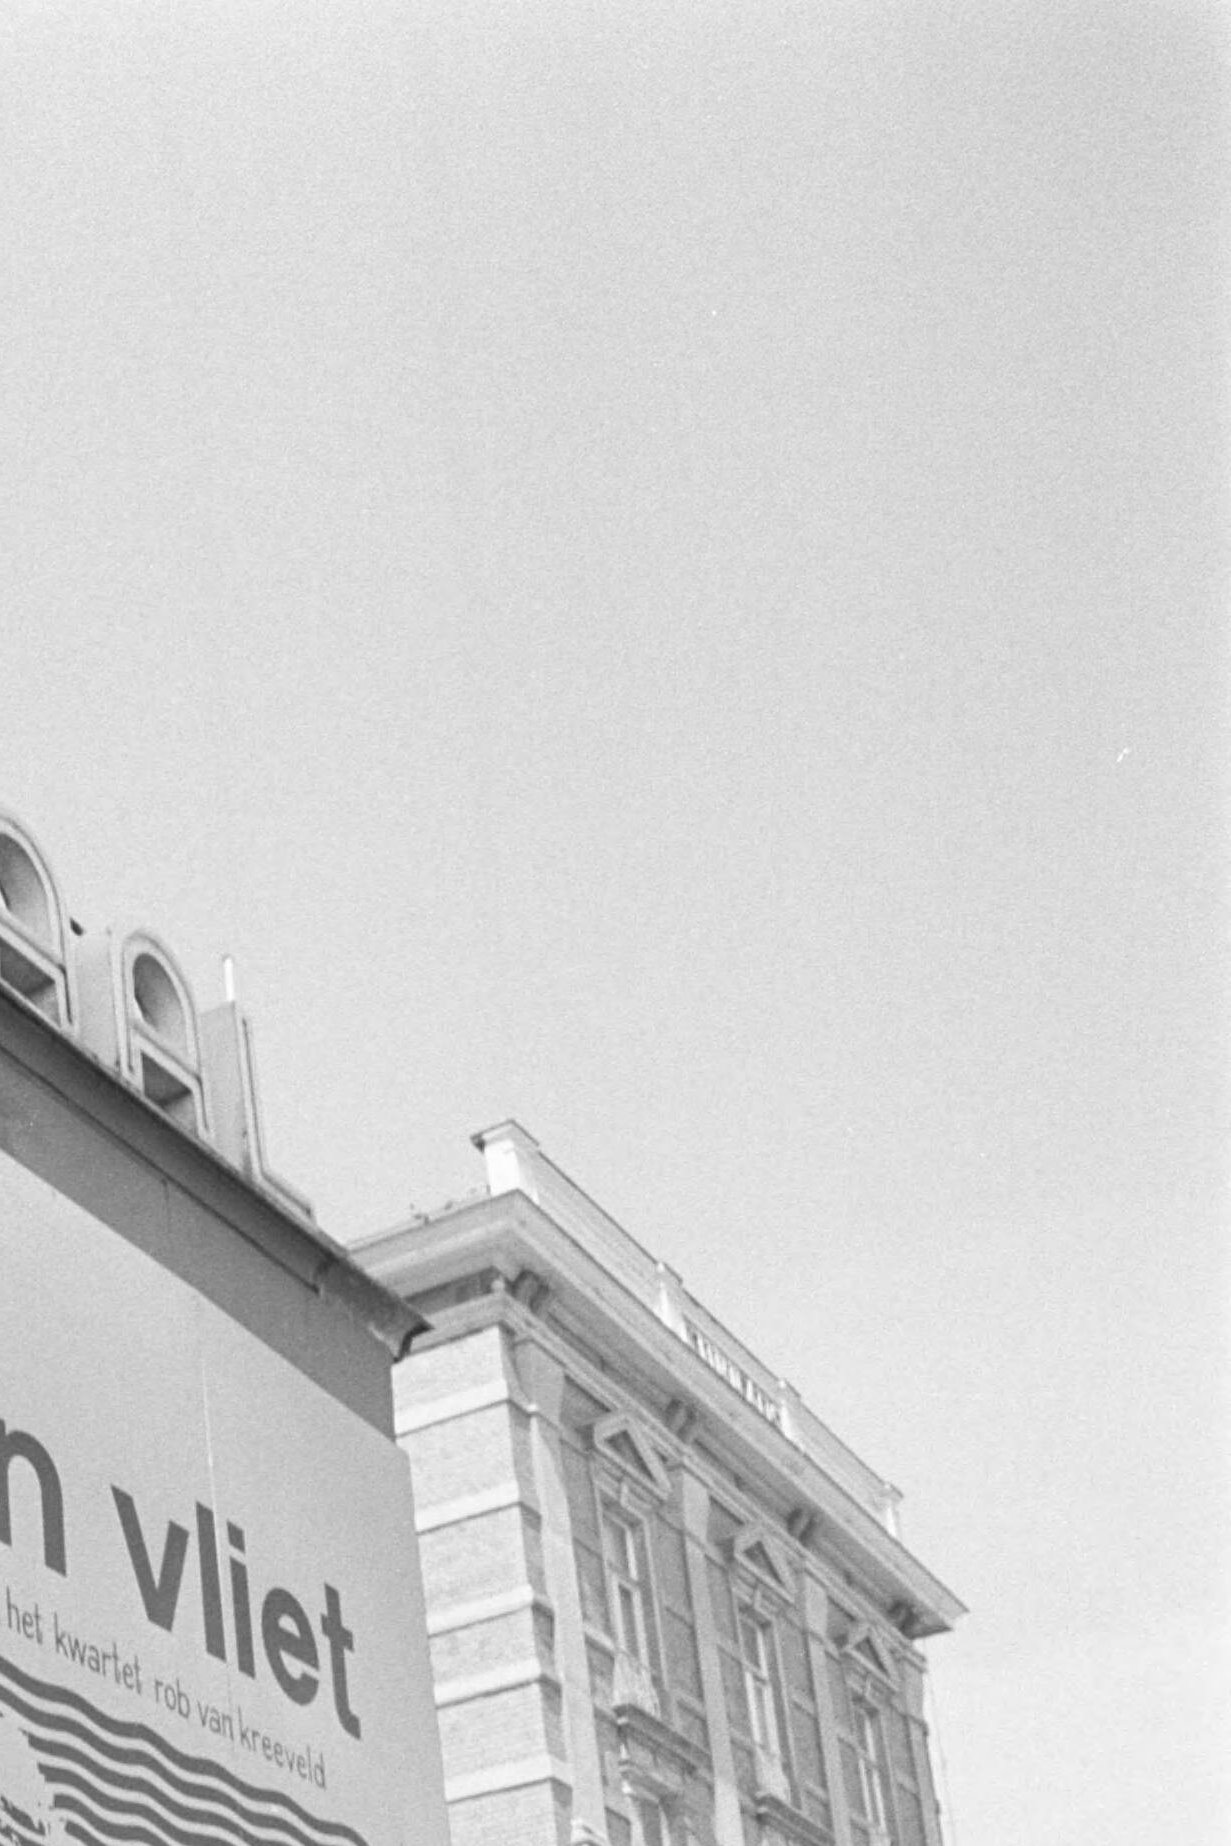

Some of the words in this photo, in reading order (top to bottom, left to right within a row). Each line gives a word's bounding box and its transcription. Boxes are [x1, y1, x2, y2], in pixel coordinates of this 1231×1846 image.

[6, 1586, 43, 1646] het
[53, 1612, 142, 1695] kwartet
[153, 1677, 191, 1720] rob
[196, 1700, 236, 1743] van
[237, 1706, 327, 1790] kreeveld
[110, 1483, 362, 1741] vliet
